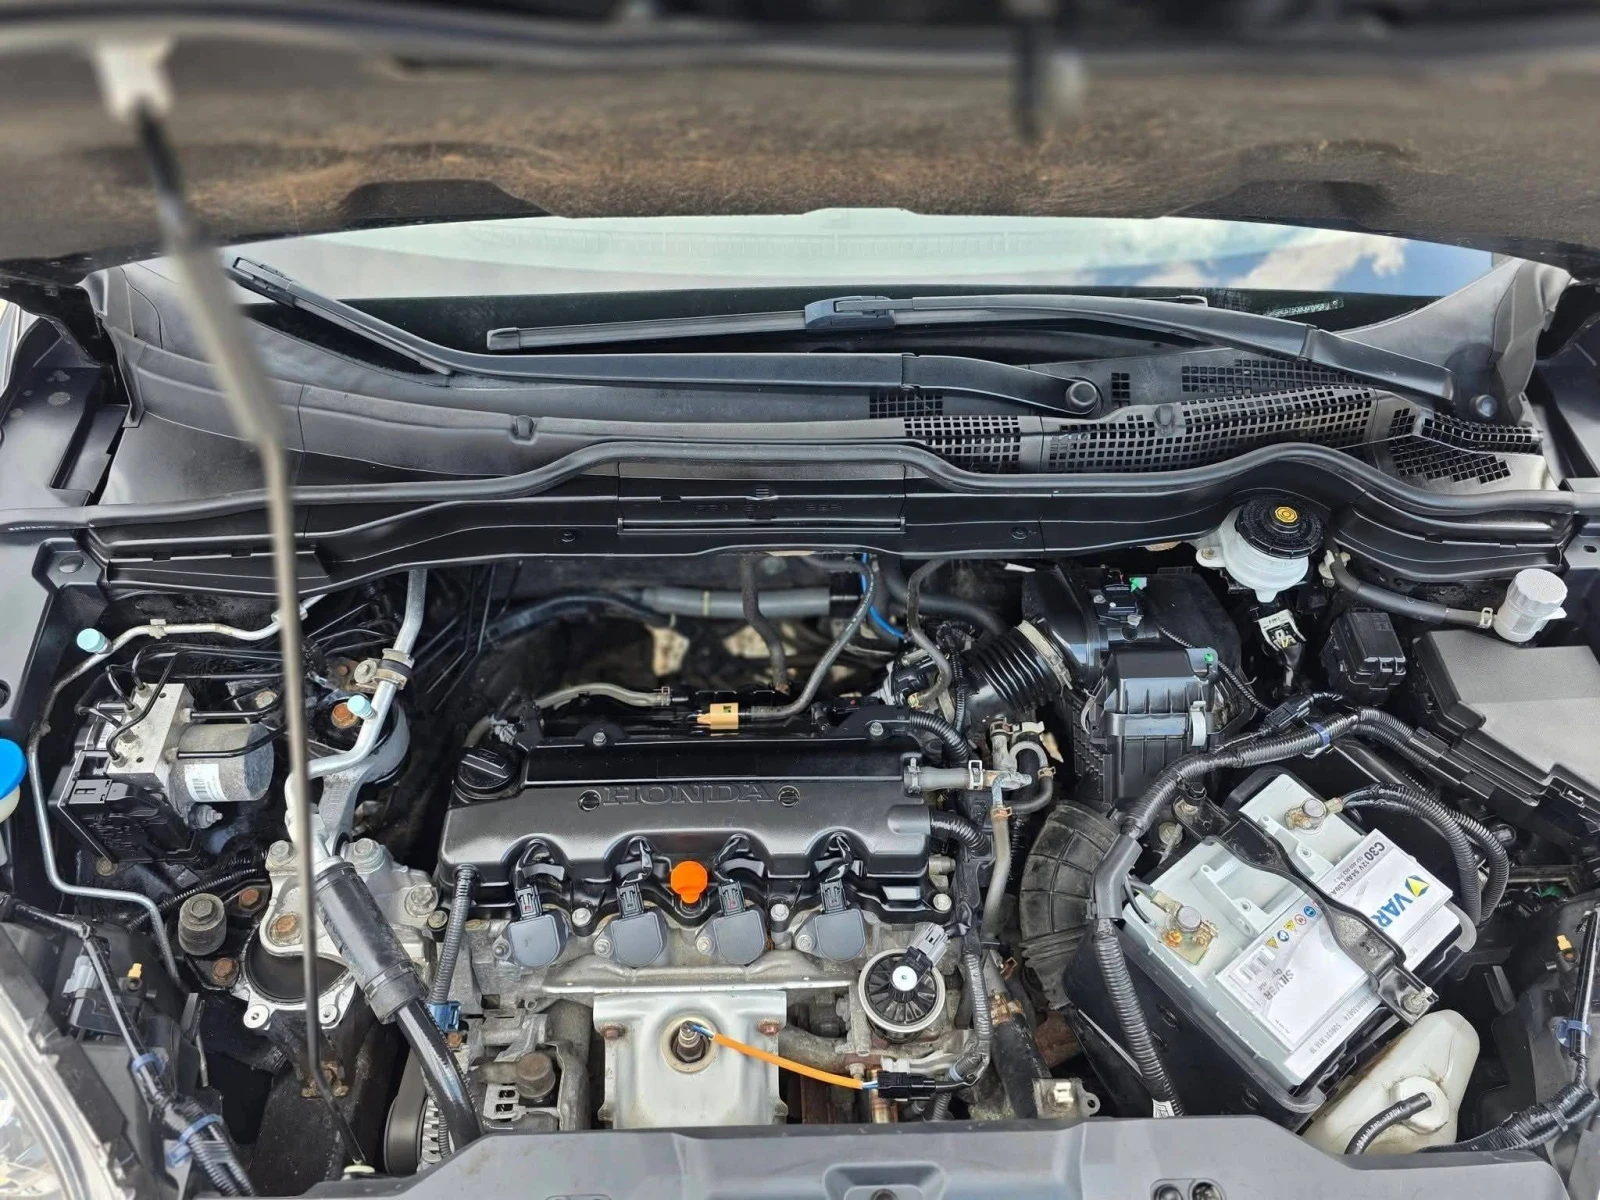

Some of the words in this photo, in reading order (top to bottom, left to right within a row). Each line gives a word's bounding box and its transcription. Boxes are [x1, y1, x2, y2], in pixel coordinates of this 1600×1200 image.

[603, 783, 775, 806] HONDA
[1364, 842, 1385, 861] C30
[1371, 893, 1413, 928] VAR
[1263, 970, 1295, 1001] SILVER
